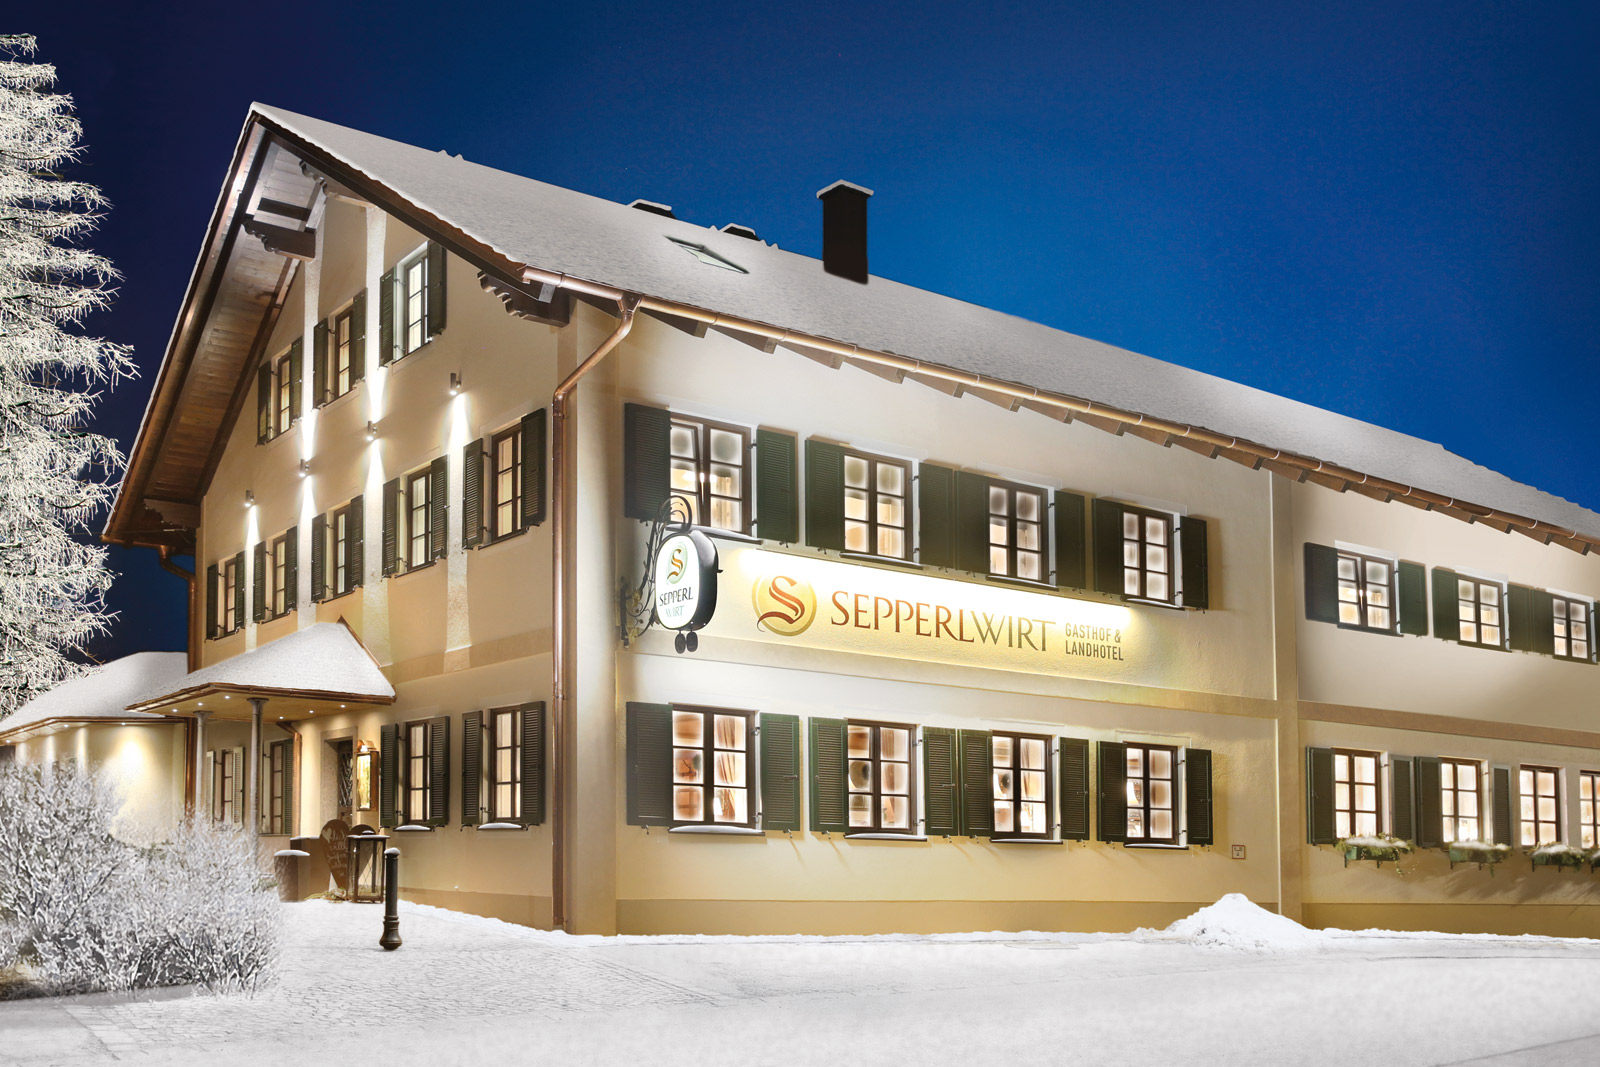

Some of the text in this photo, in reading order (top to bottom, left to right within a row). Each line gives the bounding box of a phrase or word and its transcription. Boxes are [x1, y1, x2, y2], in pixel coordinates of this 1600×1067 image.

[659, 587, 694, 607] SEPPERL
[665, 605, 685, 618] WIRT
[831, 590, 1056, 651] SEPPERLWIRT
[1065, 622, 1122, 643] GASTHOF &
[1065, 640, 1124, 661] LANDHOTEL
